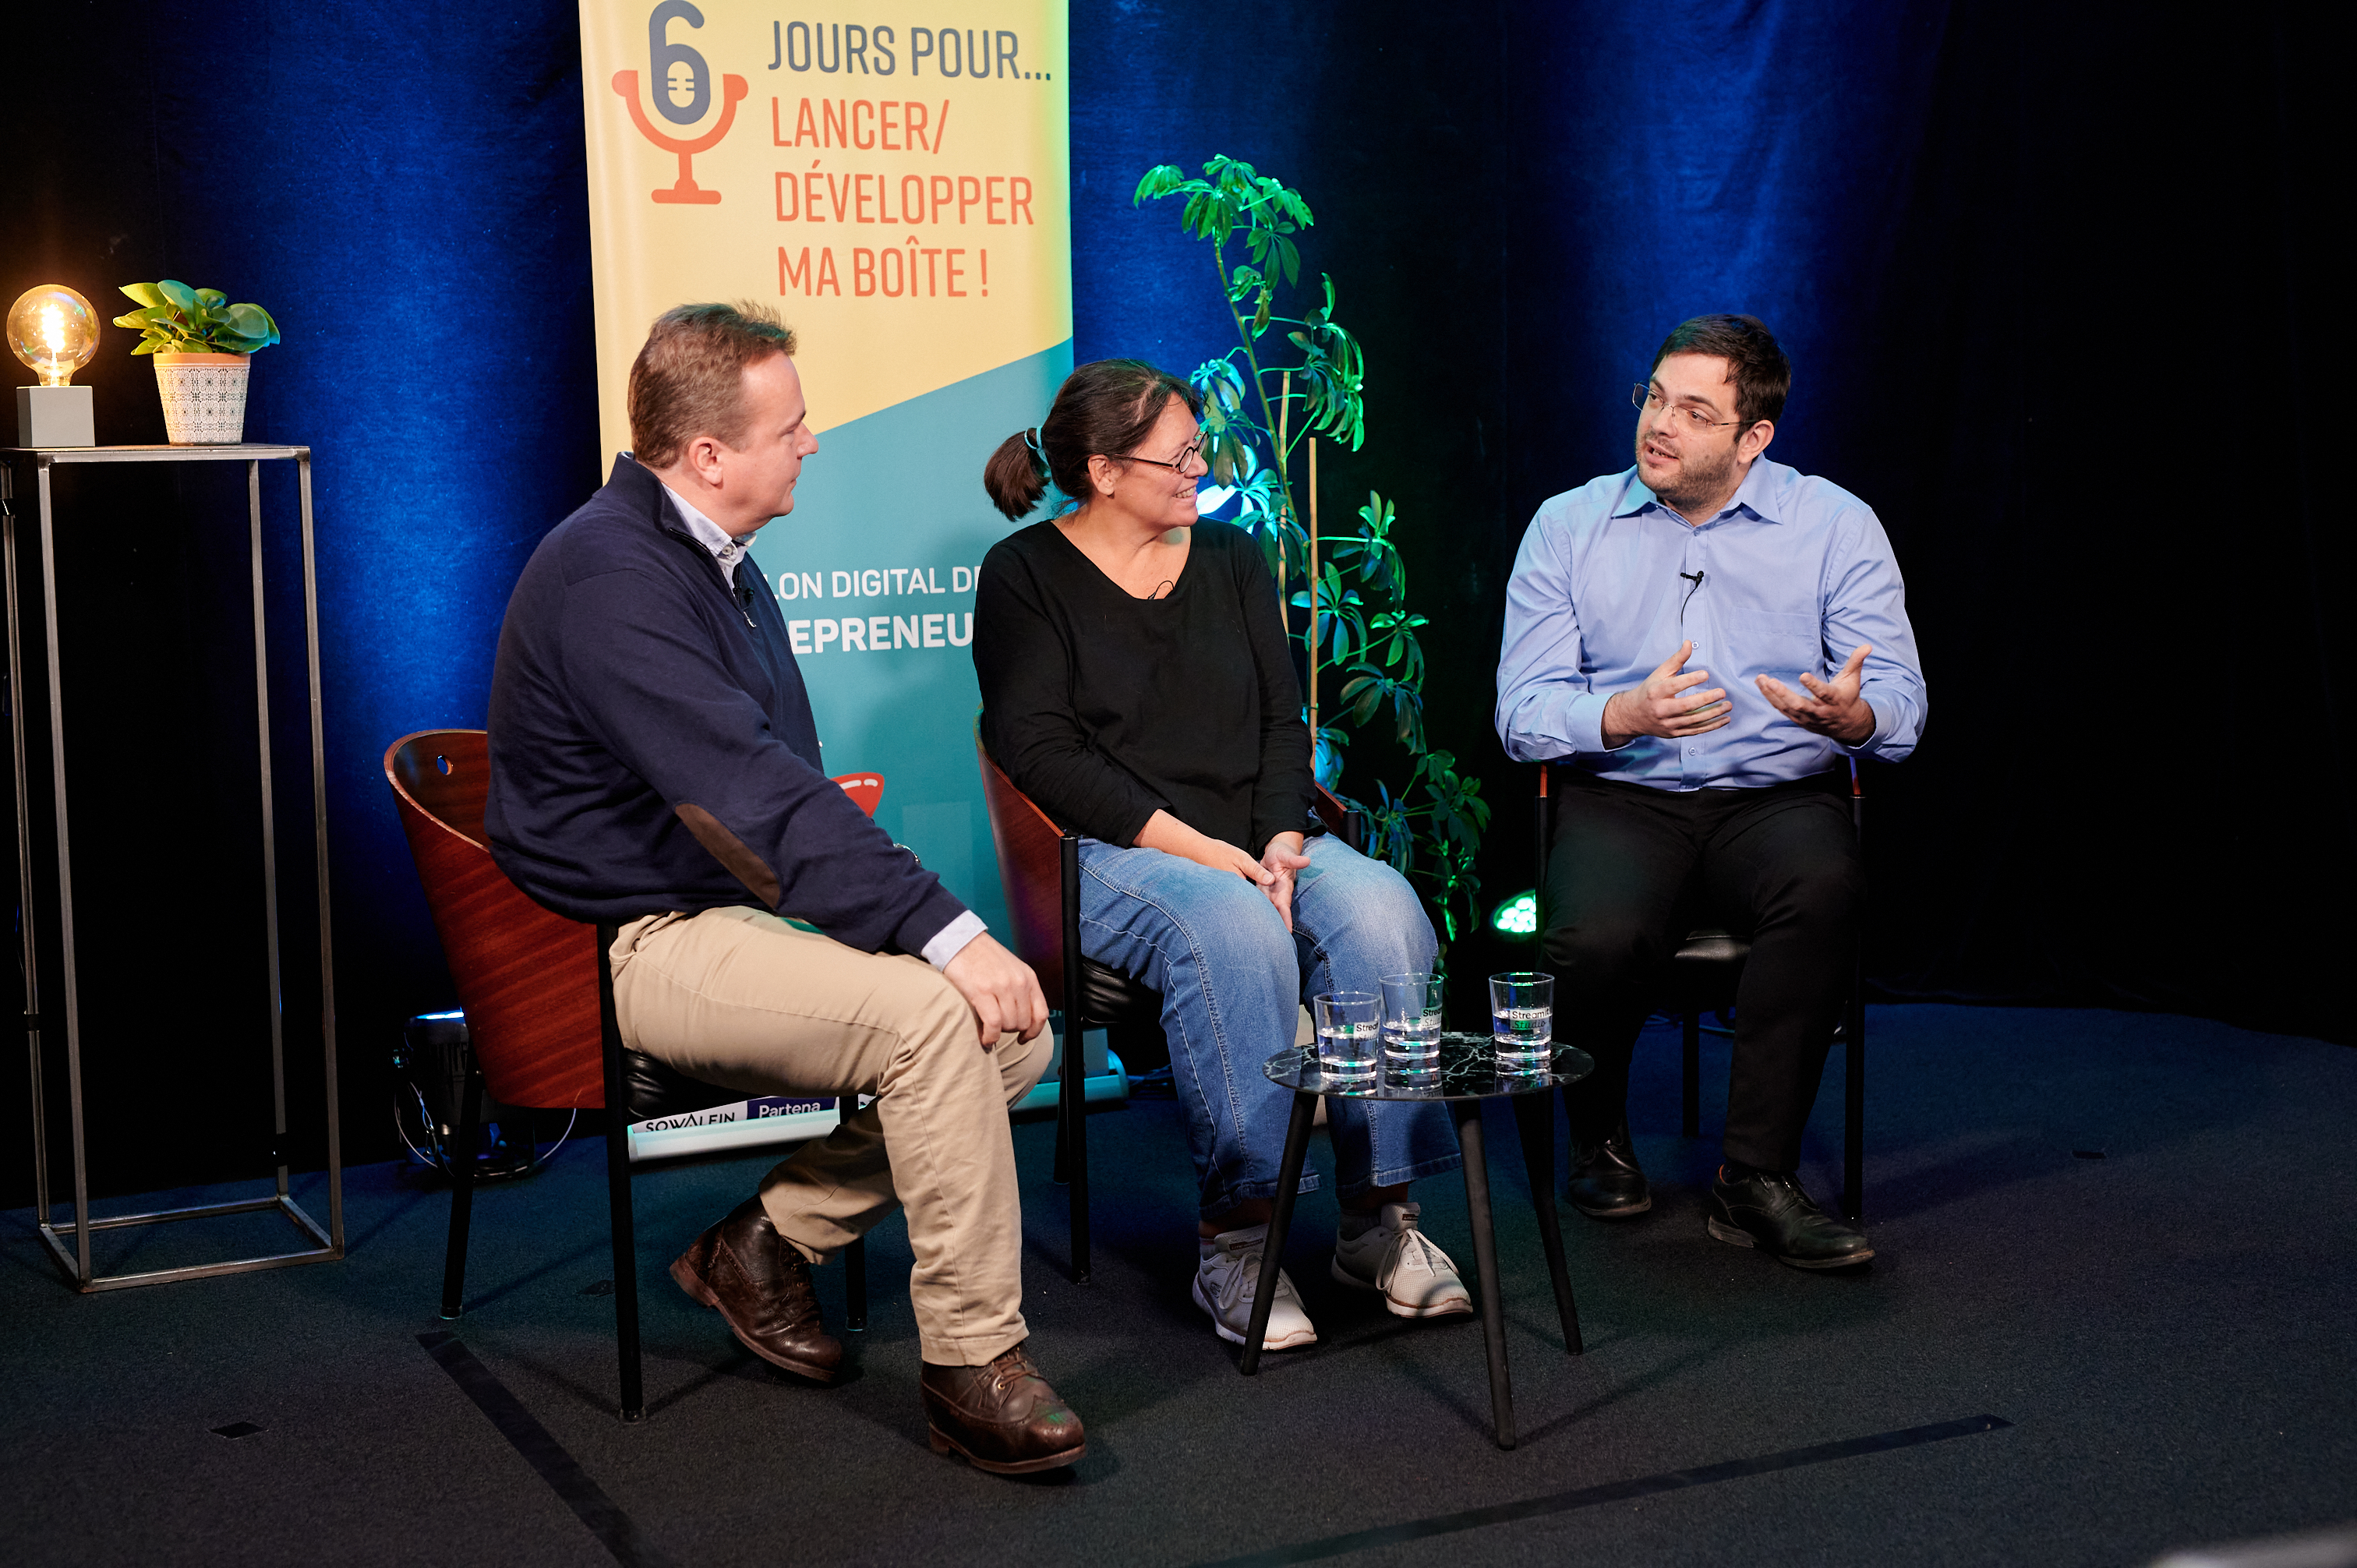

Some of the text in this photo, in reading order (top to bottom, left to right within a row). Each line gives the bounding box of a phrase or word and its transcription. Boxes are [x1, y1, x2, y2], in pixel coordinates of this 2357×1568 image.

[769, 21, 896, 76] JOURS
[911, 27, 1051, 81] POUR...
[772, 97, 949, 154] LANCER/
[776, 160, 1034, 224] DÉVELOPPER
[779, 235, 988, 298] MA BOÎTE !
[832, 567, 945, 597] DIGITAL
[759, 1102, 821, 1118] Partena
